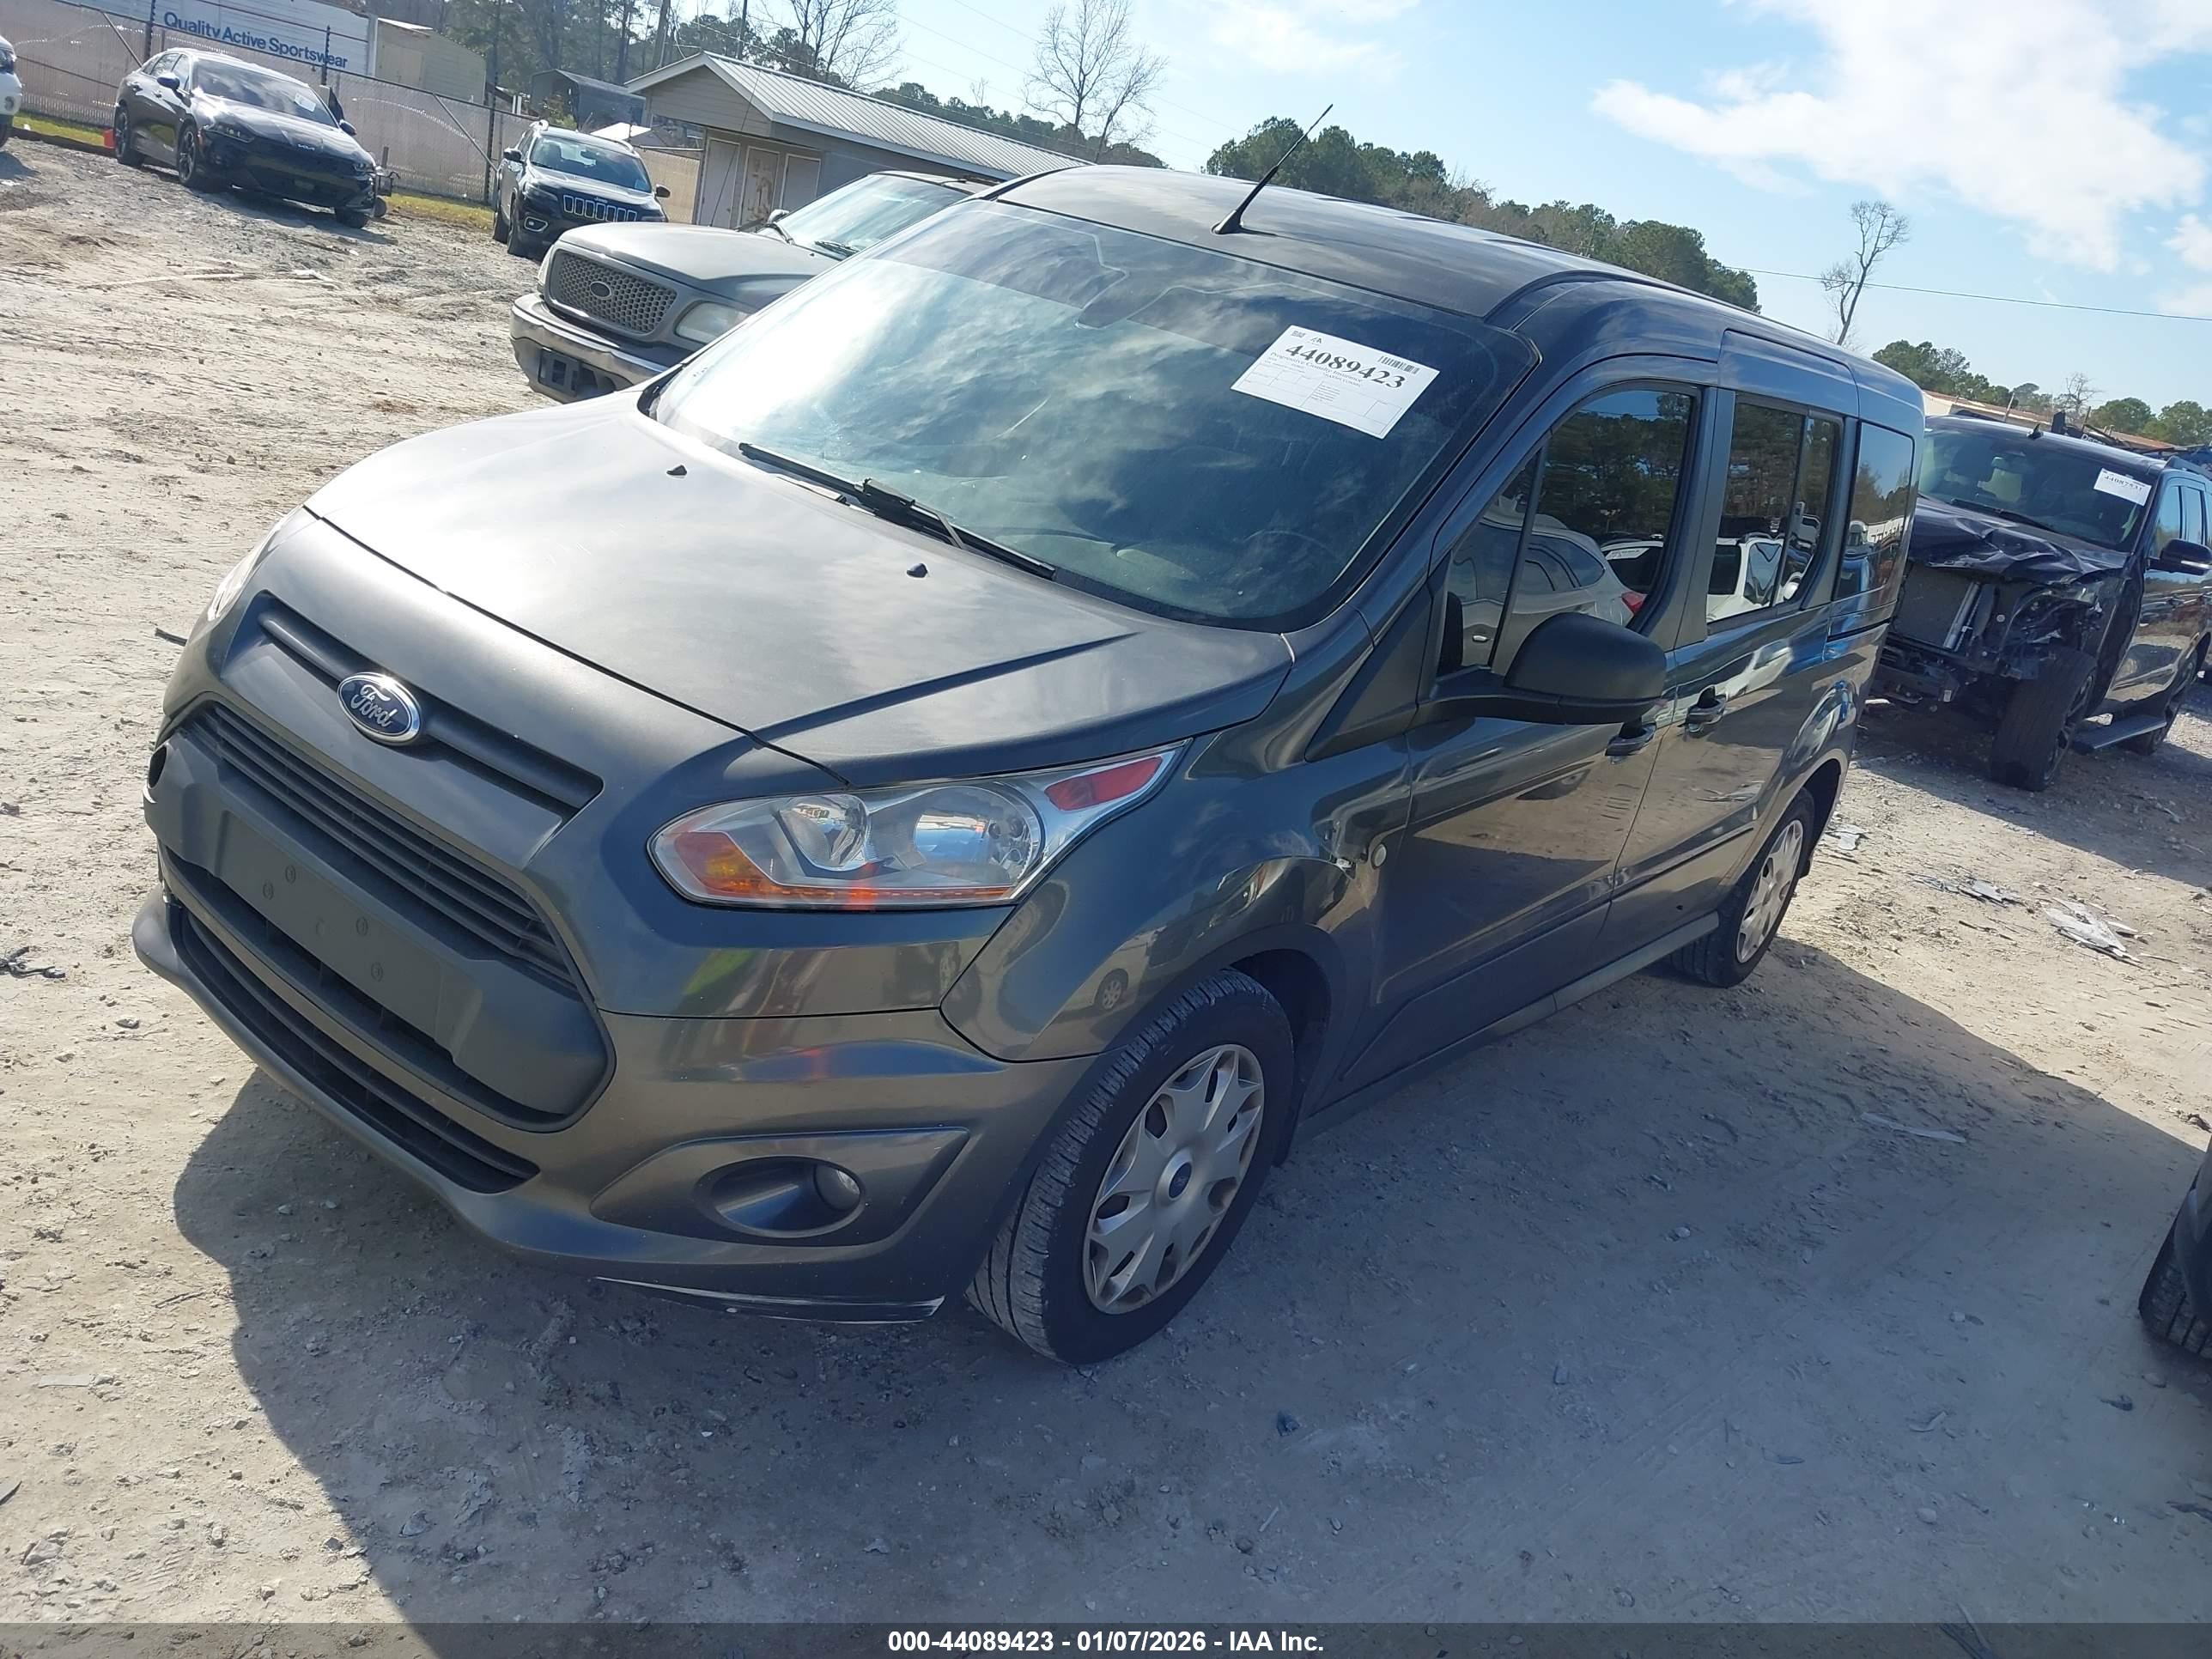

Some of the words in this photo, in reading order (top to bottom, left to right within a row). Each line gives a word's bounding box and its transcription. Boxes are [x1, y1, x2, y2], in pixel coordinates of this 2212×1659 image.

[164, 12, 221, 38] Quality
[222, 27, 266, 50] Active
[269, 37, 348, 69] Sportswear
[1285, 344, 1406, 389] 44089423
[350, 684, 398, 727] Ford
